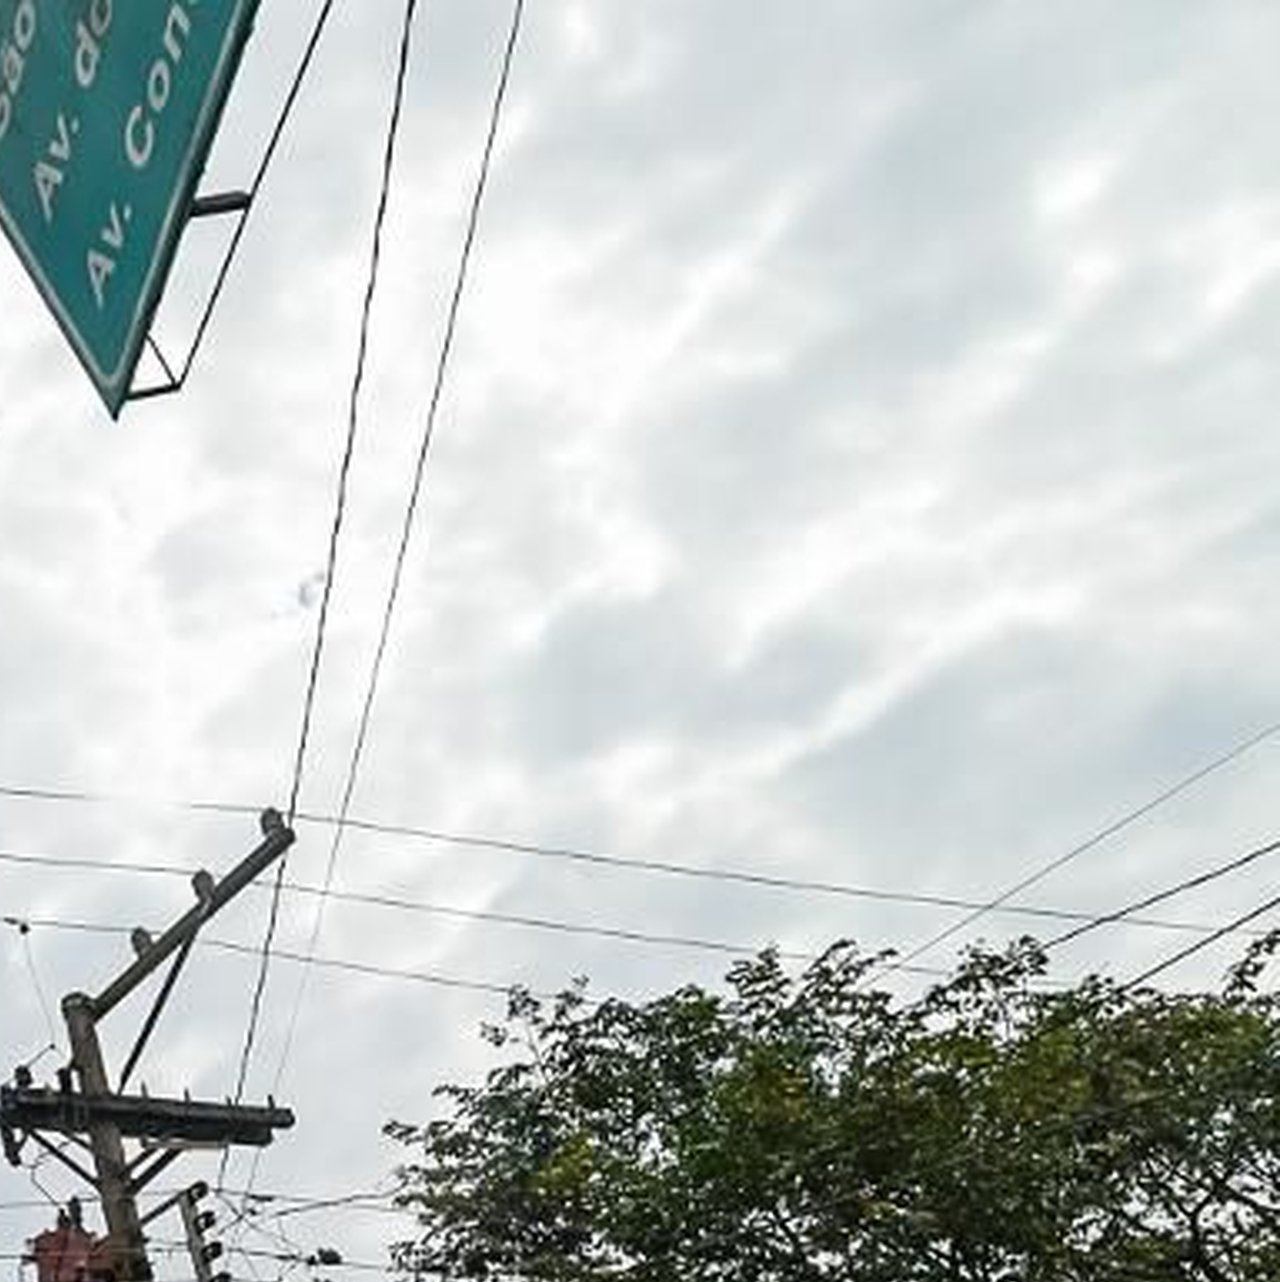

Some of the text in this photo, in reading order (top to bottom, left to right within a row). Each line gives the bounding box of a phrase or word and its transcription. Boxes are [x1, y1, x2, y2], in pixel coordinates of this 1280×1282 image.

[33, 112, 80, 224] Av.
[85, 0, 197, 310] Av. Con
